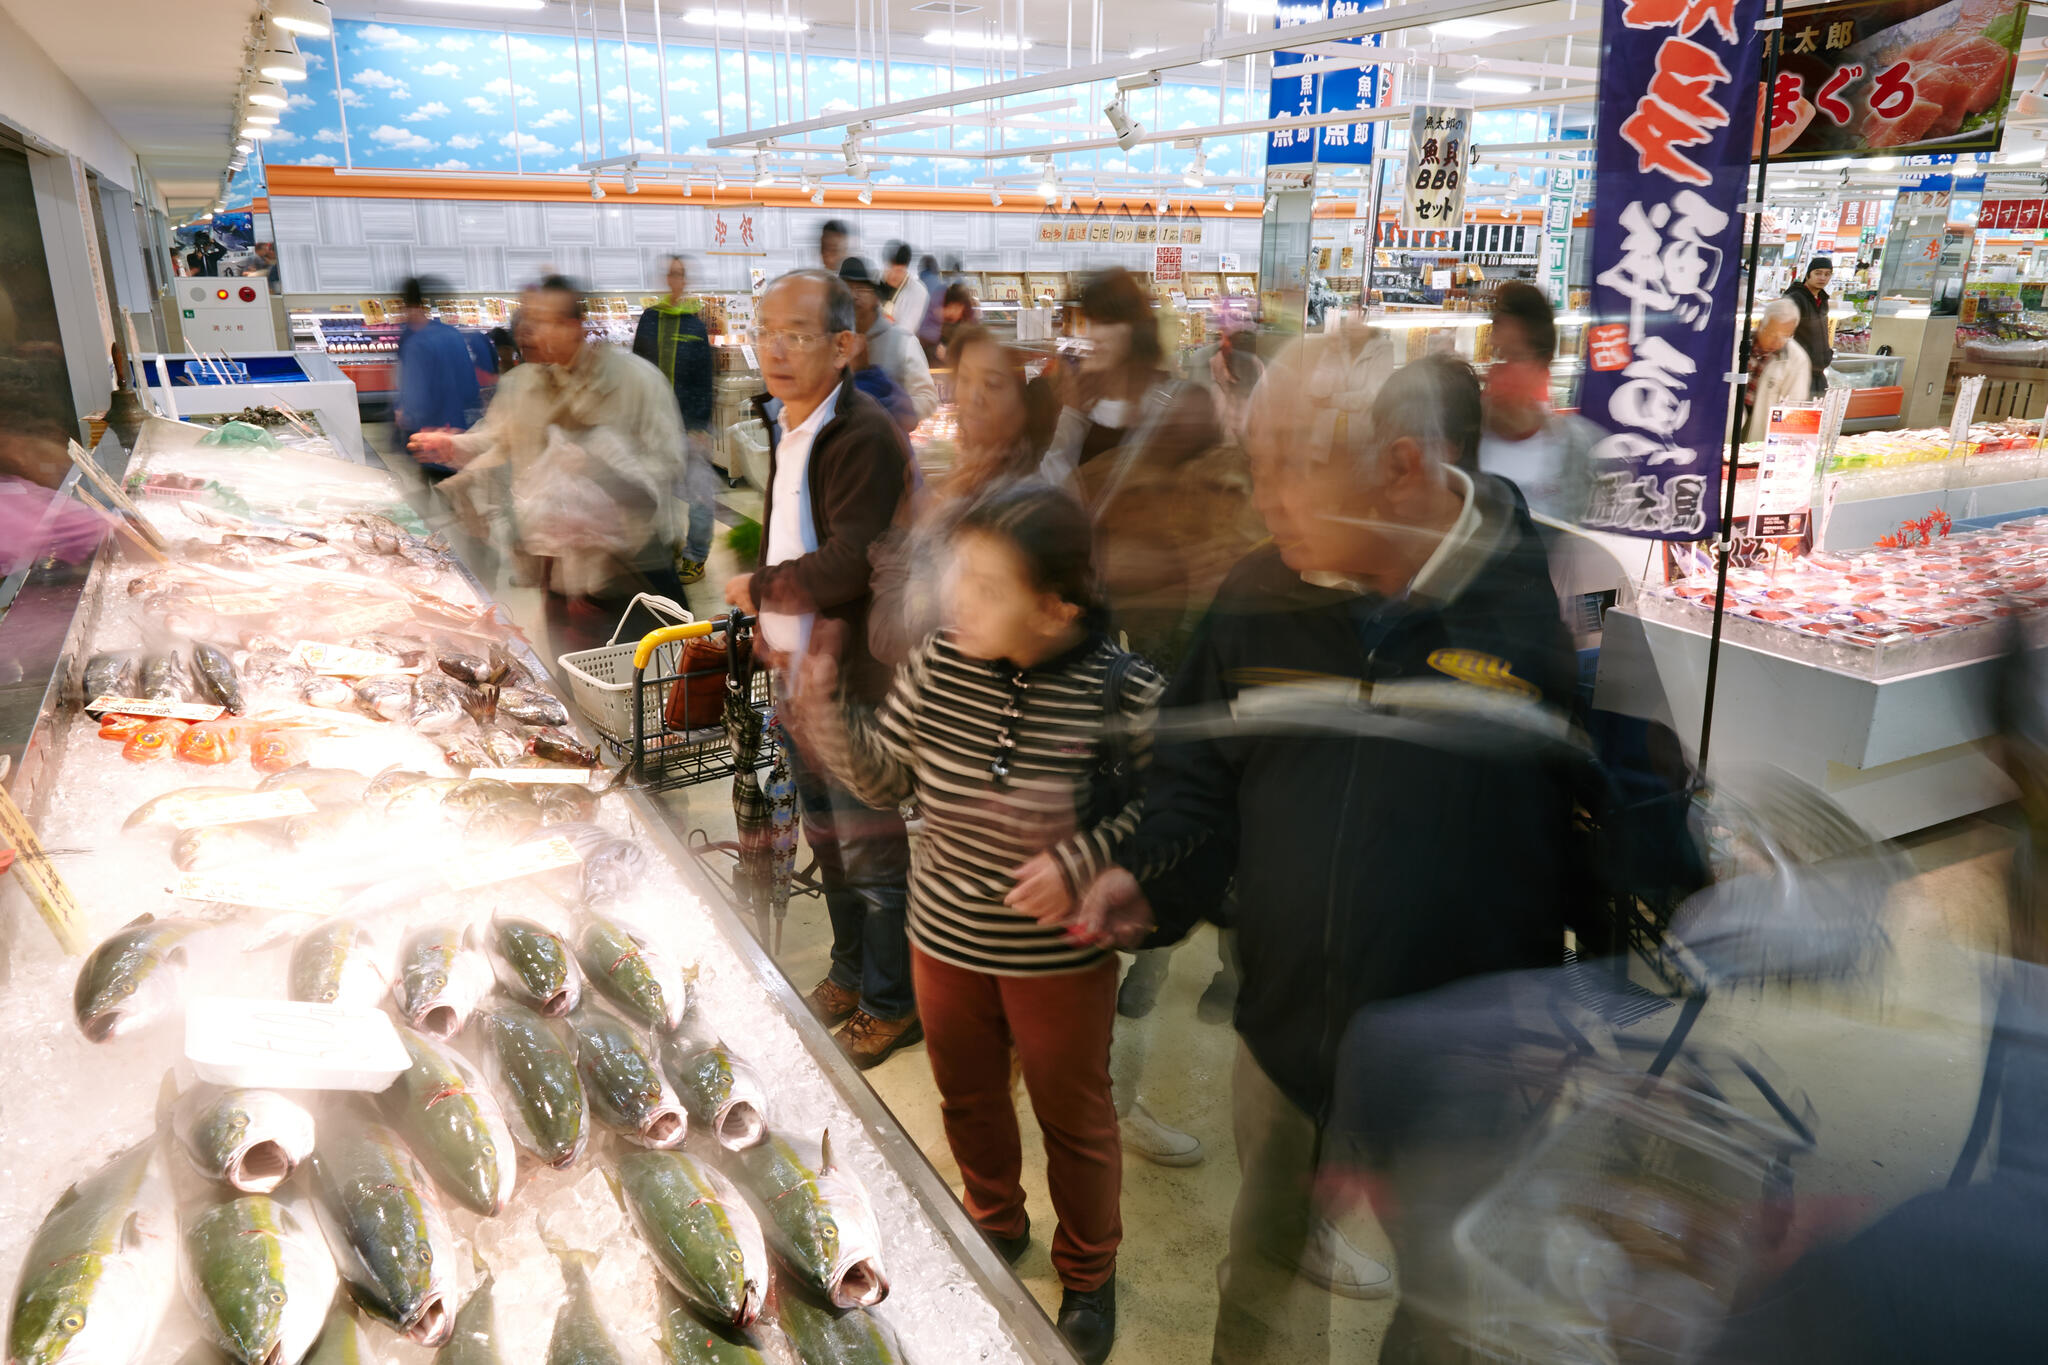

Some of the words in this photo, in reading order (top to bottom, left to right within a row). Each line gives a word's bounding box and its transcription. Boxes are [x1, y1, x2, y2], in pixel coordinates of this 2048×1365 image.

[1762, 21, 1854, 58] 魚太郎
[1762, 61, 1916, 129] まぐろ
[1424, 116, 1463, 130] 魚太郎の
[1419, 138, 1459, 167] 魚貝
[1415, 169, 1459, 190] BBQ
[1416, 196, 1453, 221] セット
[1980, 205, 2048, 223] おすす
